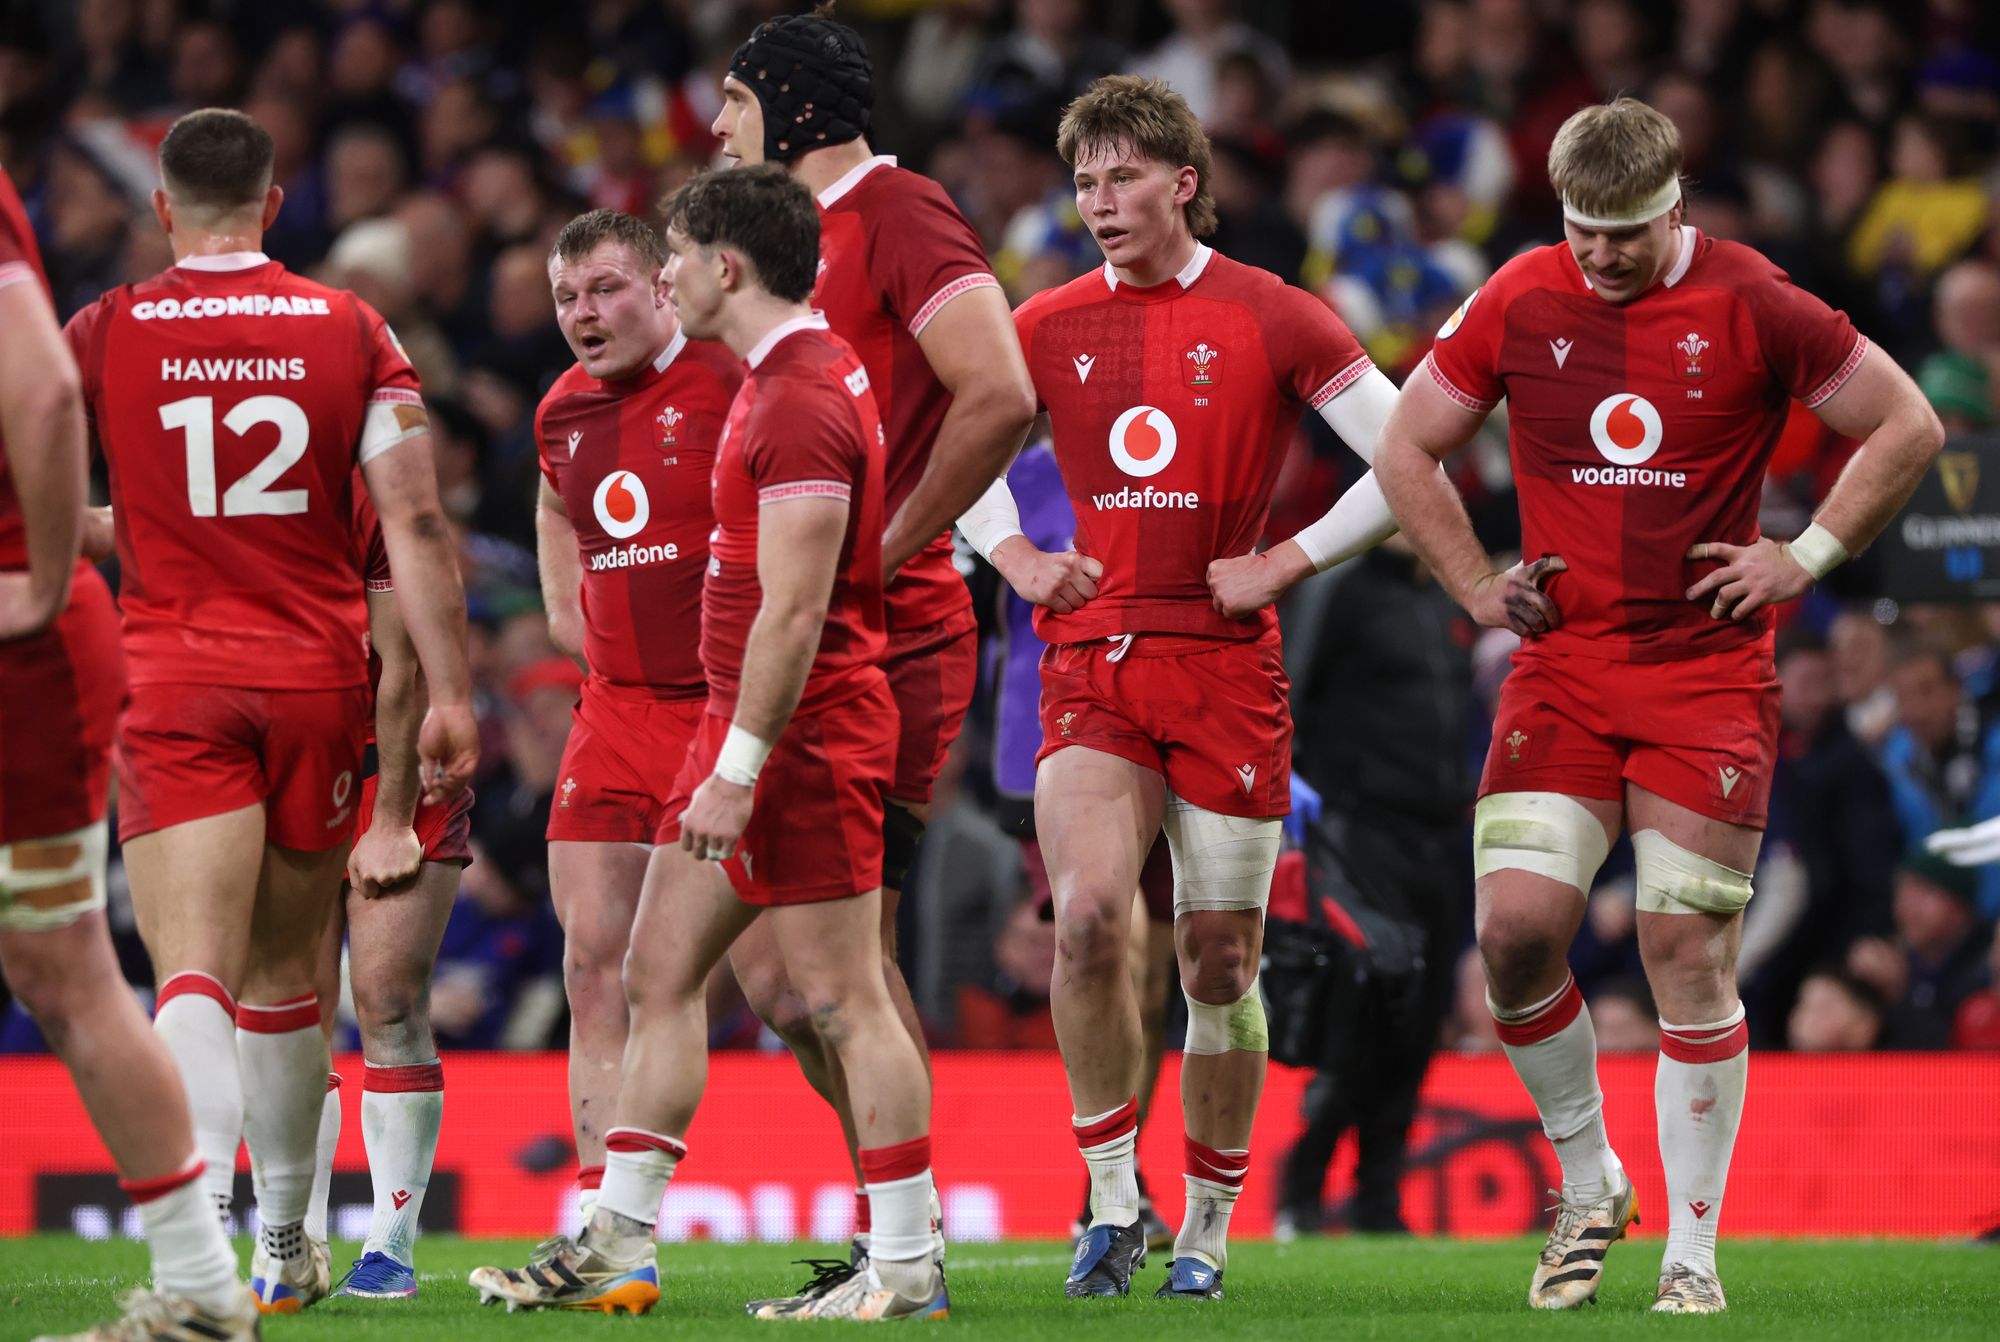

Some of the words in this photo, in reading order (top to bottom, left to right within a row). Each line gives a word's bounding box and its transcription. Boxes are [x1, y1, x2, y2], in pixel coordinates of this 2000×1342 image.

[131, 295, 330, 320] GO.COMPARE
[161, 358, 306, 381] HAWKINS
[1194, 398, 1208, 406] 1211
[158, 394, 310, 517] 12
[1571, 466, 1686, 488] vodafone
[1092, 485, 1199, 511] vodafone
[591, 543, 678, 571] vodafone
